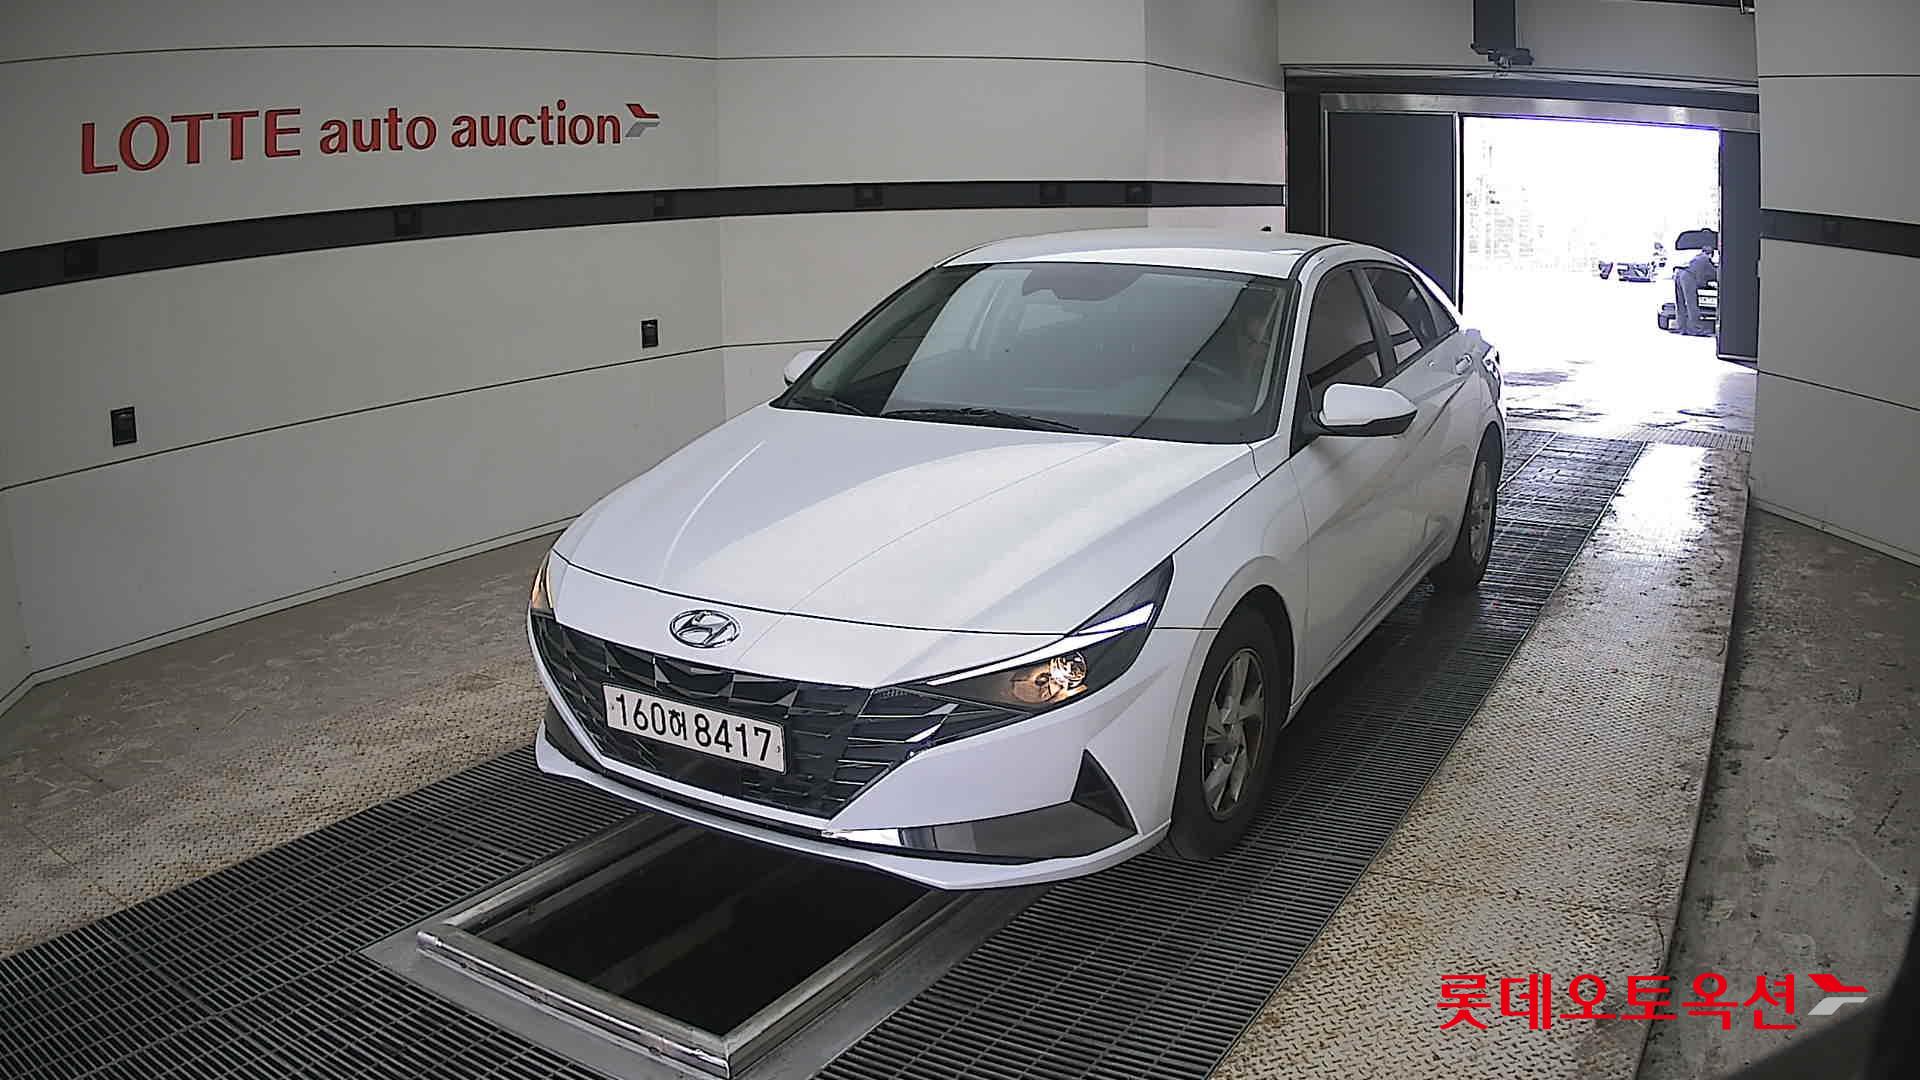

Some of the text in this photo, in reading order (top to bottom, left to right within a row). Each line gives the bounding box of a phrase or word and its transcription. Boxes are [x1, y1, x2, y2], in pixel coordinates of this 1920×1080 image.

[81, 99, 622, 174] LOTTE auto auction
